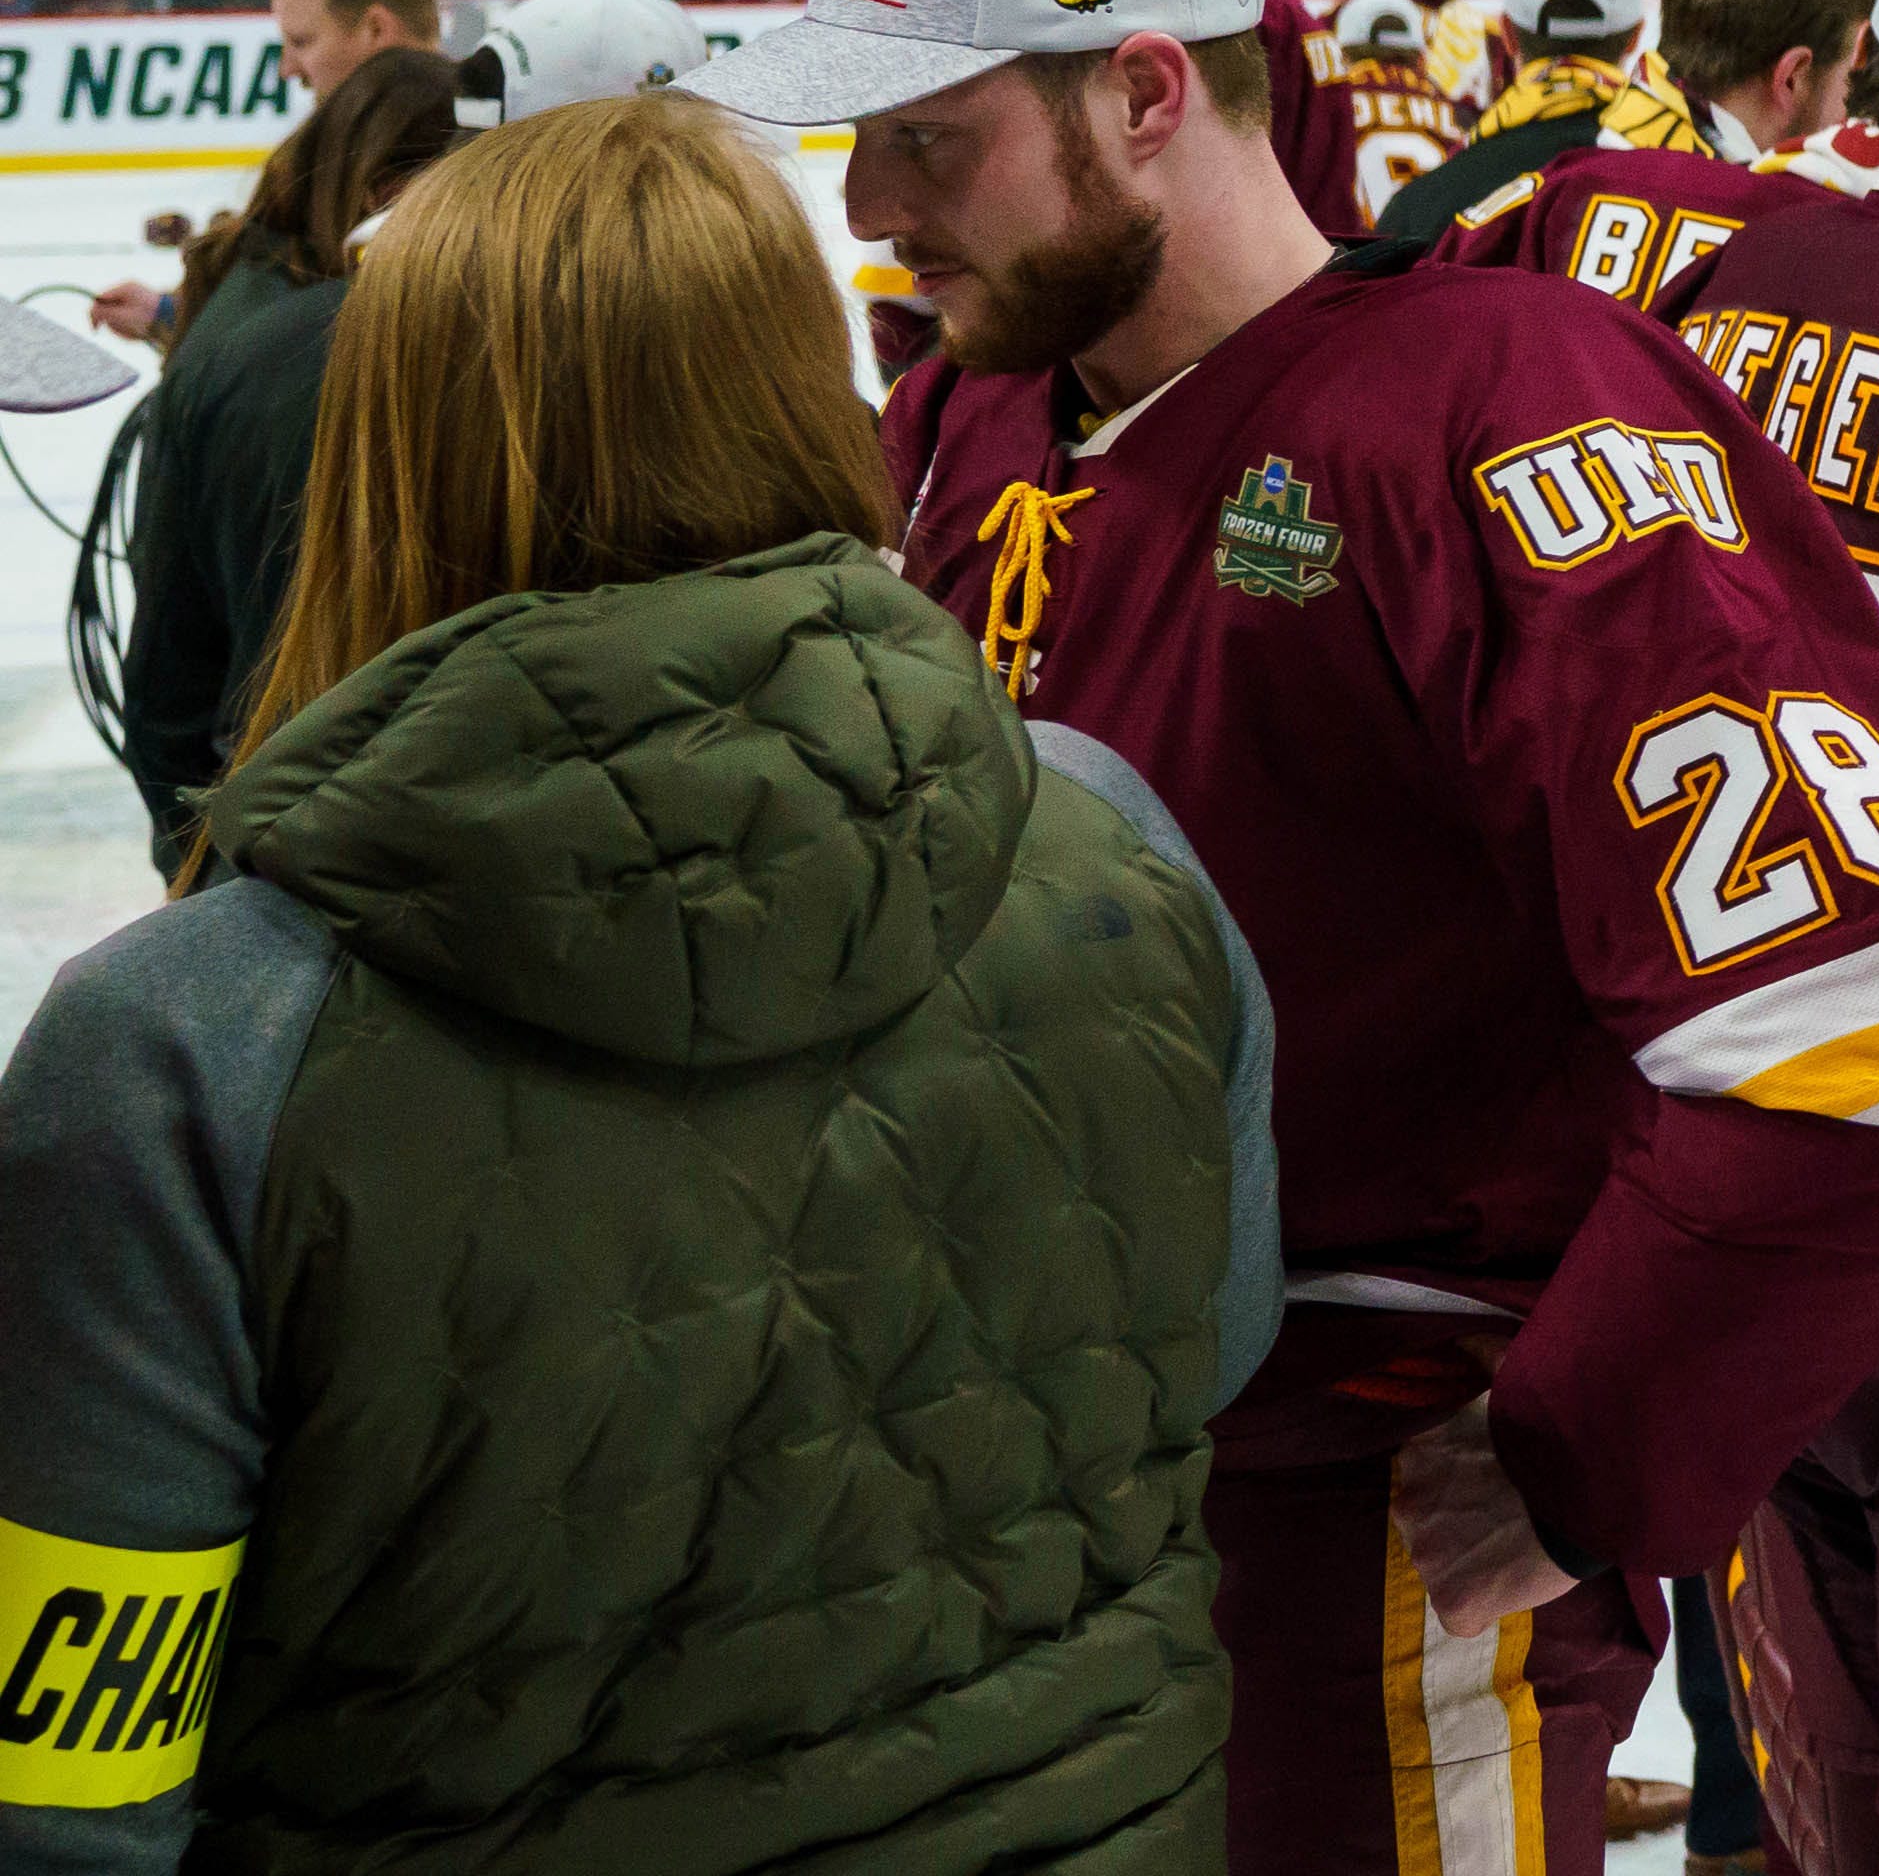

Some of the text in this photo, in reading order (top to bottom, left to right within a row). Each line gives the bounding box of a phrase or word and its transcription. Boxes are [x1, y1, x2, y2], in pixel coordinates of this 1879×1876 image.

[62, 43, 293, 121] NCAA
[1472, 416, 1750, 572] UMD
[1222, 511, 1276, 546] FROZEN
[1275, 526, 1328, 557] FOUR
